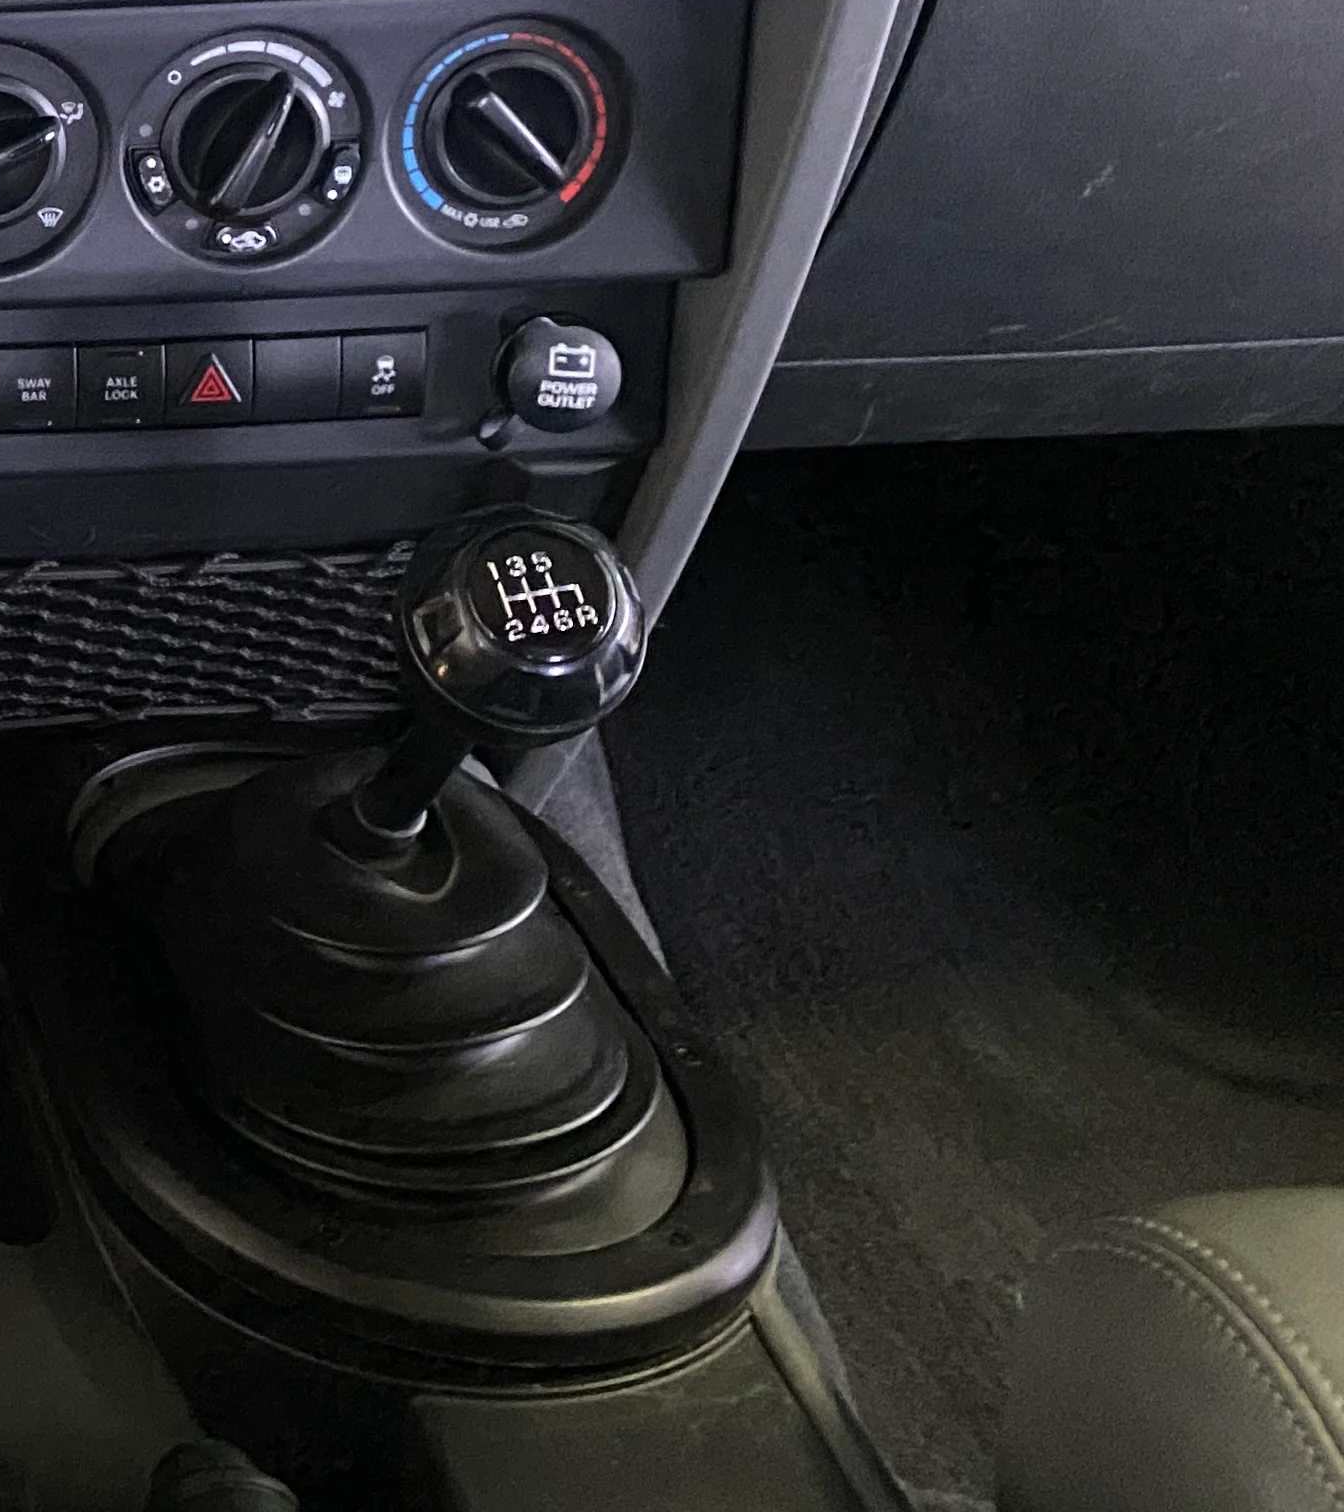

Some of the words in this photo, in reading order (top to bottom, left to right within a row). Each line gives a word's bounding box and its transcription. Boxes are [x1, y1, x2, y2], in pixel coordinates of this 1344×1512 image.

[17, 377, 51, 390] SWAY
[105, 375, 138, 388] AXLE
[539, 379, 599, 396] POWER
[21, 390, 47, 402] BAR
[104, 389, 139, 401] LOCK
[370, 383, 396, 396] OFF
[537, 393, 596, 409] OUTLET
[486, 561, 499, 581] 1
[505, 555, 527, 577] 3
[531, 550, 553, 573] 5
[504, 619, 526, 642] 2
[530, 613, 550, 634] 4
[553, 609, 574, 632] 6
[575, 604, 599, 628] R
